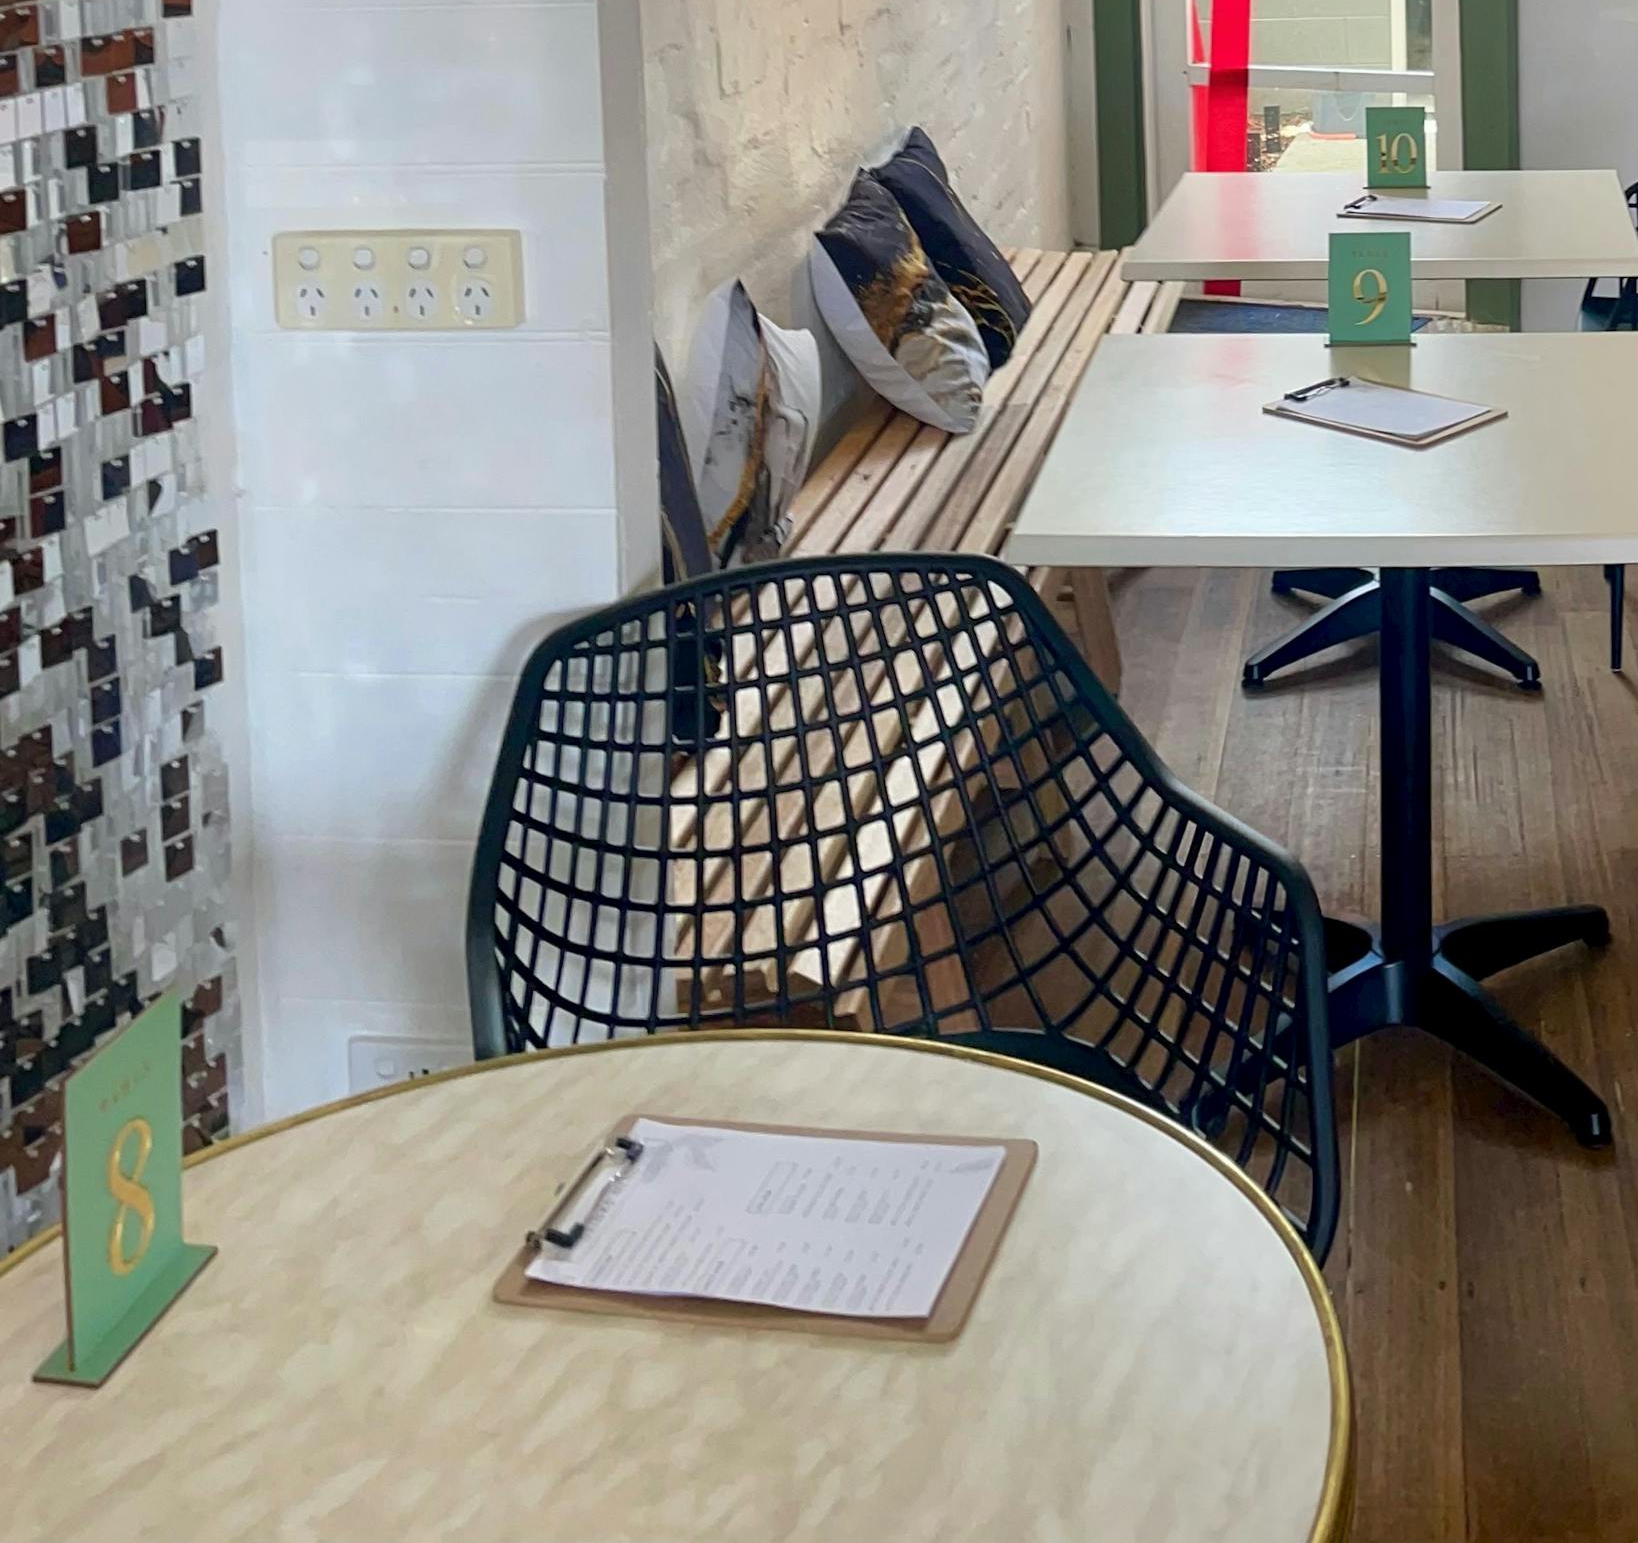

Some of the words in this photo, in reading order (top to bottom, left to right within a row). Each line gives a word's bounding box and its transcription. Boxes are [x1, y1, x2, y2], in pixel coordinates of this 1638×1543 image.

[1375, 132, 1418, 175] 10
[1352, 268, 1389, 326] 9
[106, 1113, 156, 1279] 8
